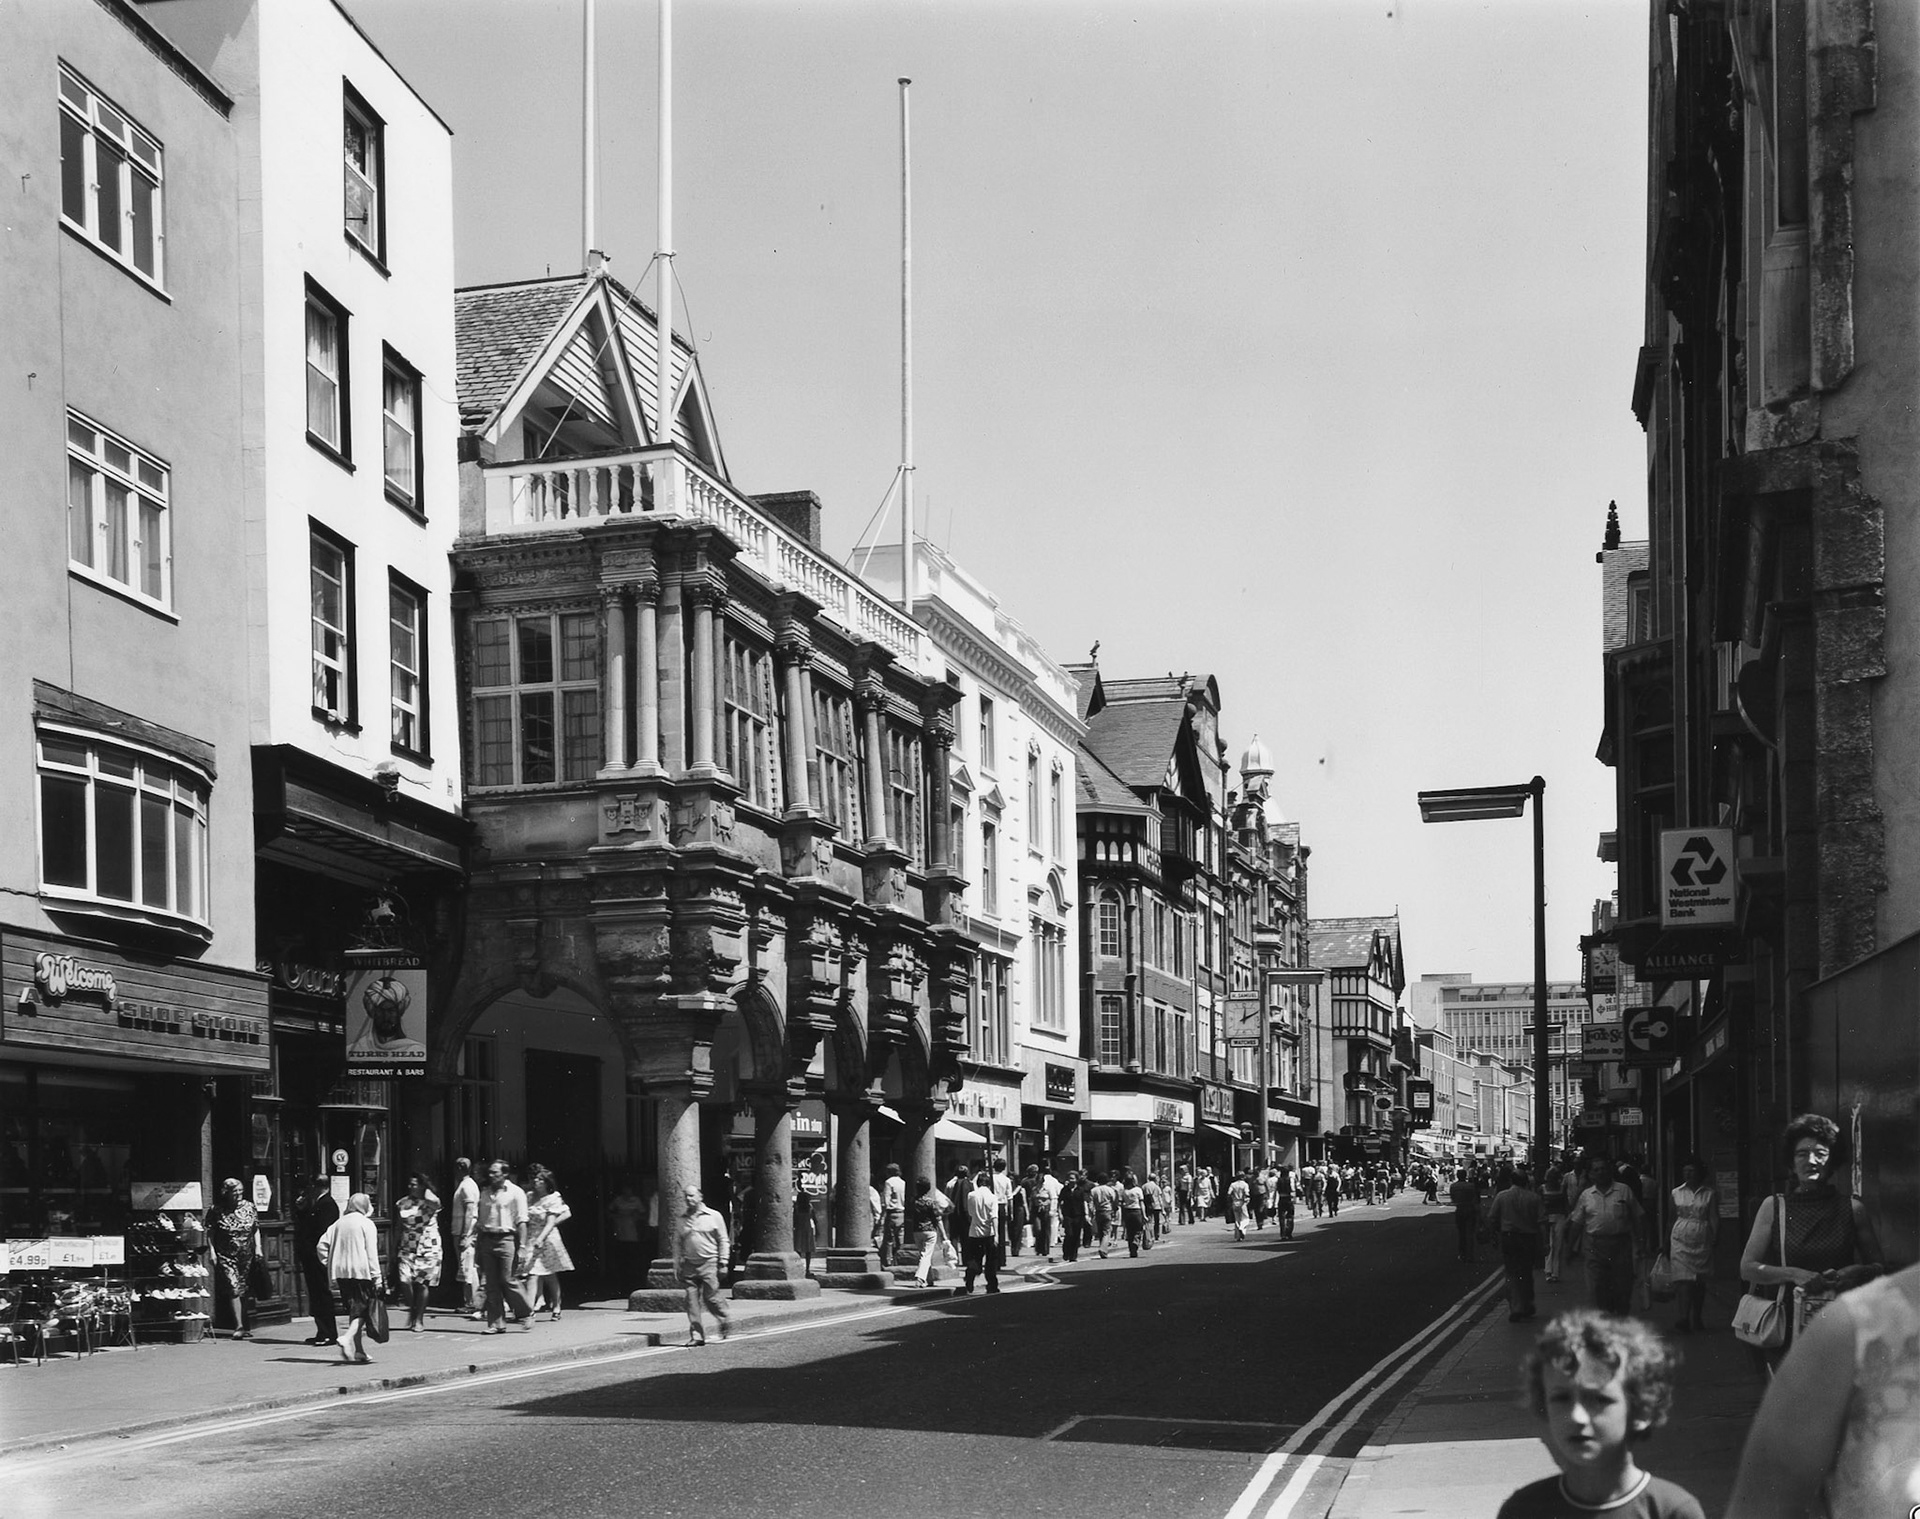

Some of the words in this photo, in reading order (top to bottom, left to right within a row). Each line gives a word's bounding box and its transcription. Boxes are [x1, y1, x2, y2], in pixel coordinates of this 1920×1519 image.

[1669, 887, 1710, 898] National
[1668, 898, 1731, 908] Westminster
[1669, 908, 1696, 918] Bank
[353, 957, 420, 967] WHITBREAD
[1645, 953, 1715, 968] ALLIANCE
[37, 953, 117, 1002] Welcome
[19, 987, 42, 1005] A
[118, 1002, 186, 1025] SHOE
[193, 1012, 266, 1035] STORE
[348, 1050, 389, 1058] TURKS
[391, 1050, 425, 1058] HEAD
[796, 1111, 810, 1131] in
